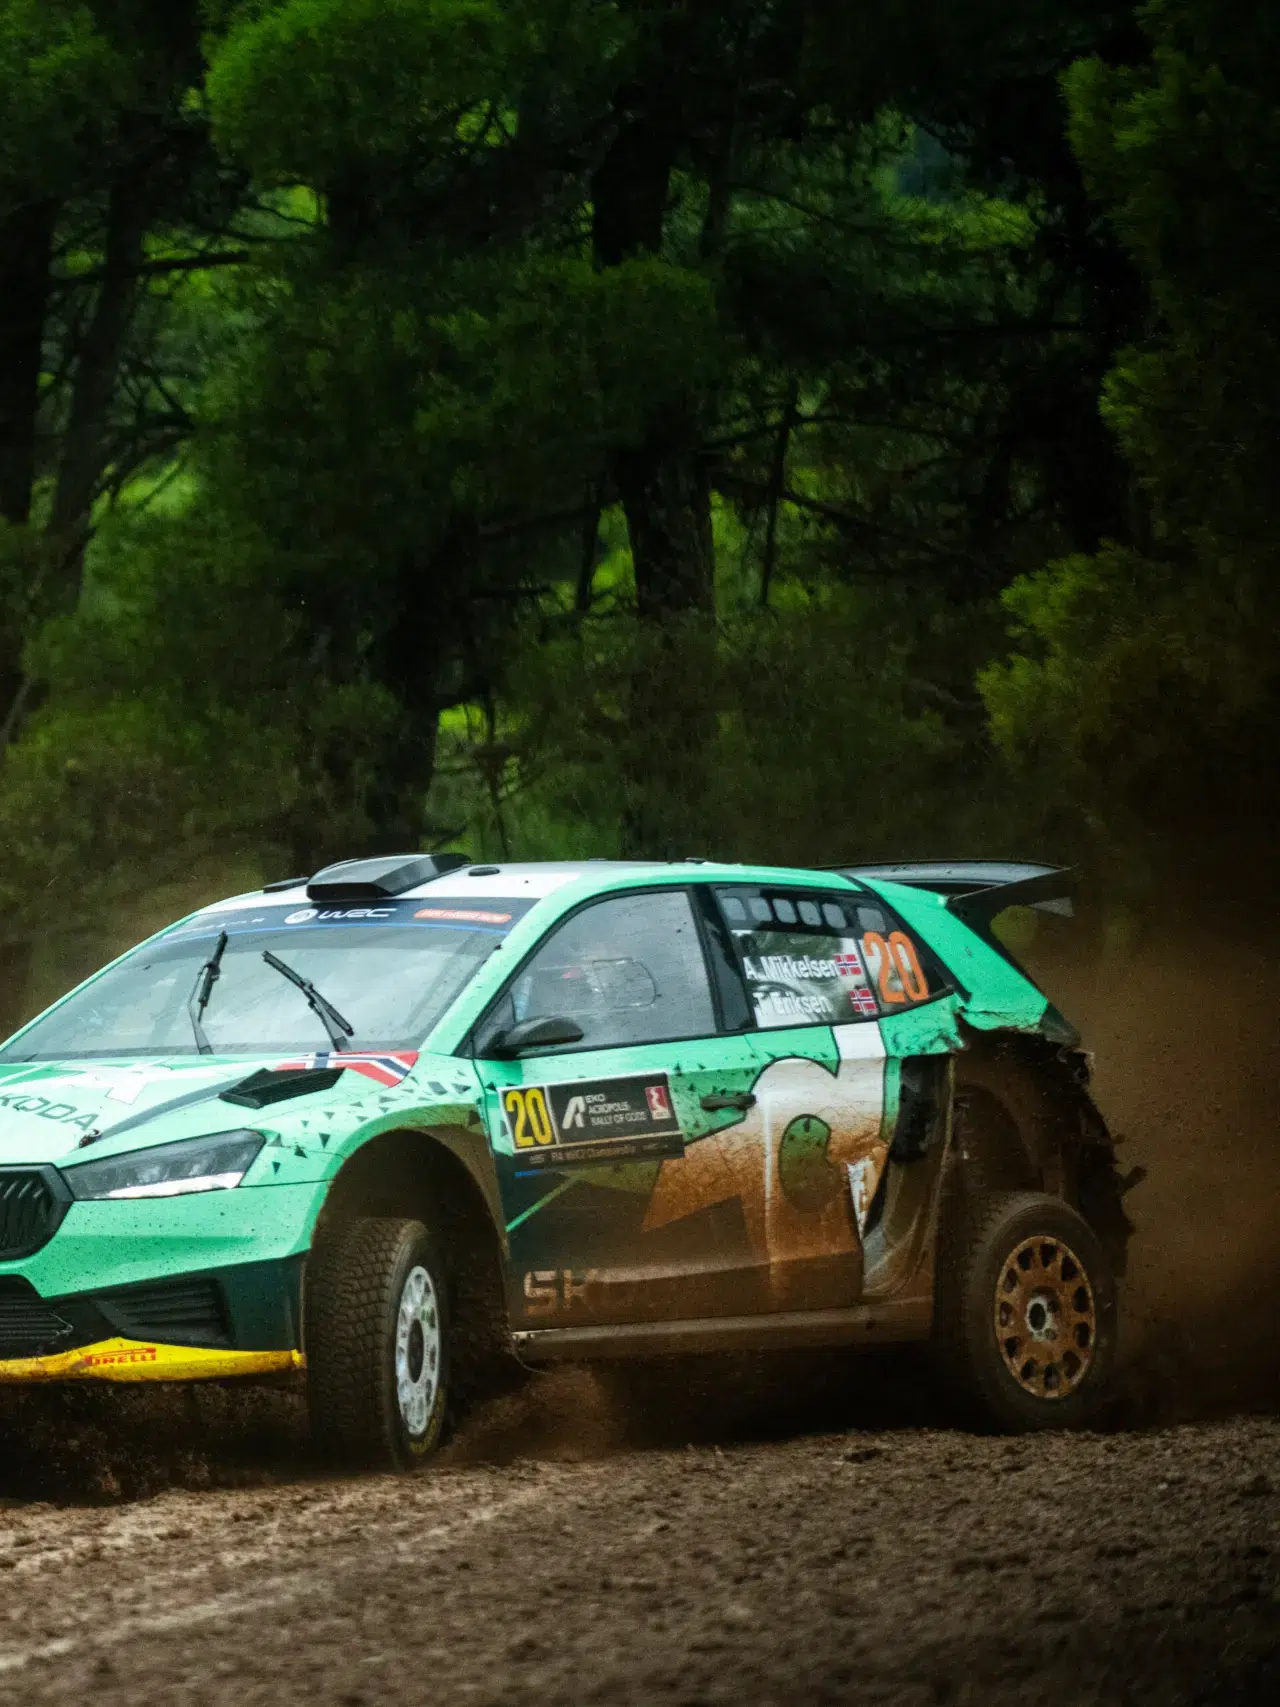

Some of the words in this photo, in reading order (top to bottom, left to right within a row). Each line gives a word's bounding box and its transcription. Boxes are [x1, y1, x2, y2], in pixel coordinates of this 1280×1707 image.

[317, 907, 398, 920] WRC
[760, 955, 840, 981] Mikkelsen
[863, 931, 929, 1004] 20
[769, 990, 834, 1016] Eriksen
[585, 1093, 606, 1104] EKO
[505, 1088, 553, 1147] 20
[590, 1113, 614, 1126] RALLY
[613, 1112, 626, 1124] OF
[84, 1347, 157, 1366] PIRELLI
